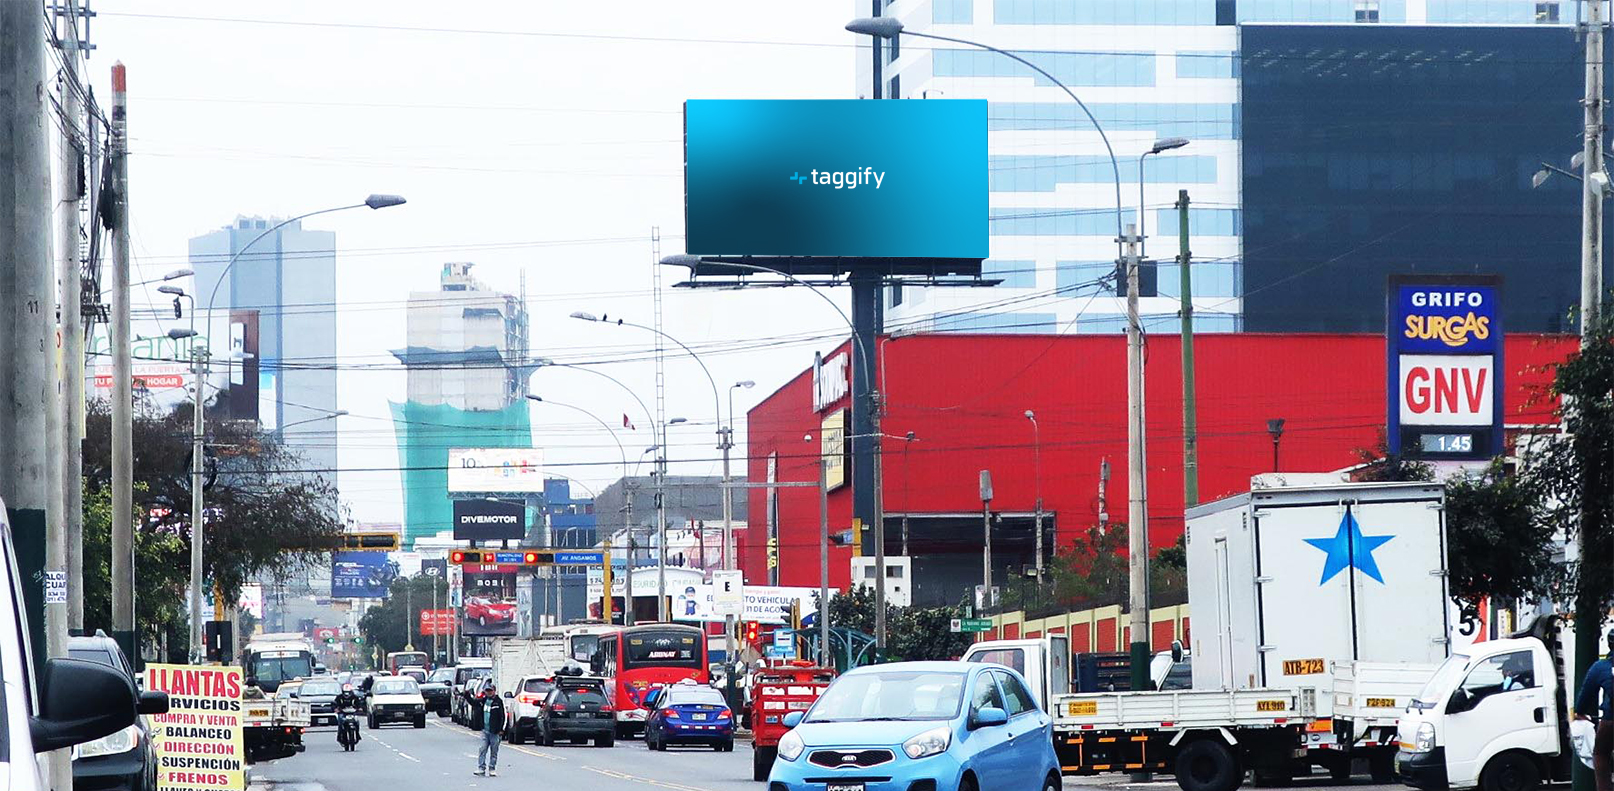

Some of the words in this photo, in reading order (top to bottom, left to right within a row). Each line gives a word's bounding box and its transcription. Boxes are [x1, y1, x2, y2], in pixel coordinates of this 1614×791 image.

[811, 167, 885, 189] taggify
[1412, 292, 1483, 307] GRIFO
[1405, 312, 1490, 346] SURGAS
[1406, 366, 1487, 414] GNV
[1438, 436, 1471, 451] 1.45
[461, 516, 517, 524] DIVEMOTOR
[724, 581, 731, 592] E
[1284, 659, 1324, 675] ATB-723
[150, 668, 240, 699] LLANTAS
[170, 698, 241, 711] RVICIOS
[153, 713, 196, 725] COMPRA
[198, 715, 205, 725] Y
[207, 715, 238, 727] VENTA
[165, 726, 232, 740] BALANCEO
[164, 741, 235, 755] DIRECCIÓN
[161, 756, 240, 771] SUSPENCIÓN
[168, 772, 229, 785] FRENOS
